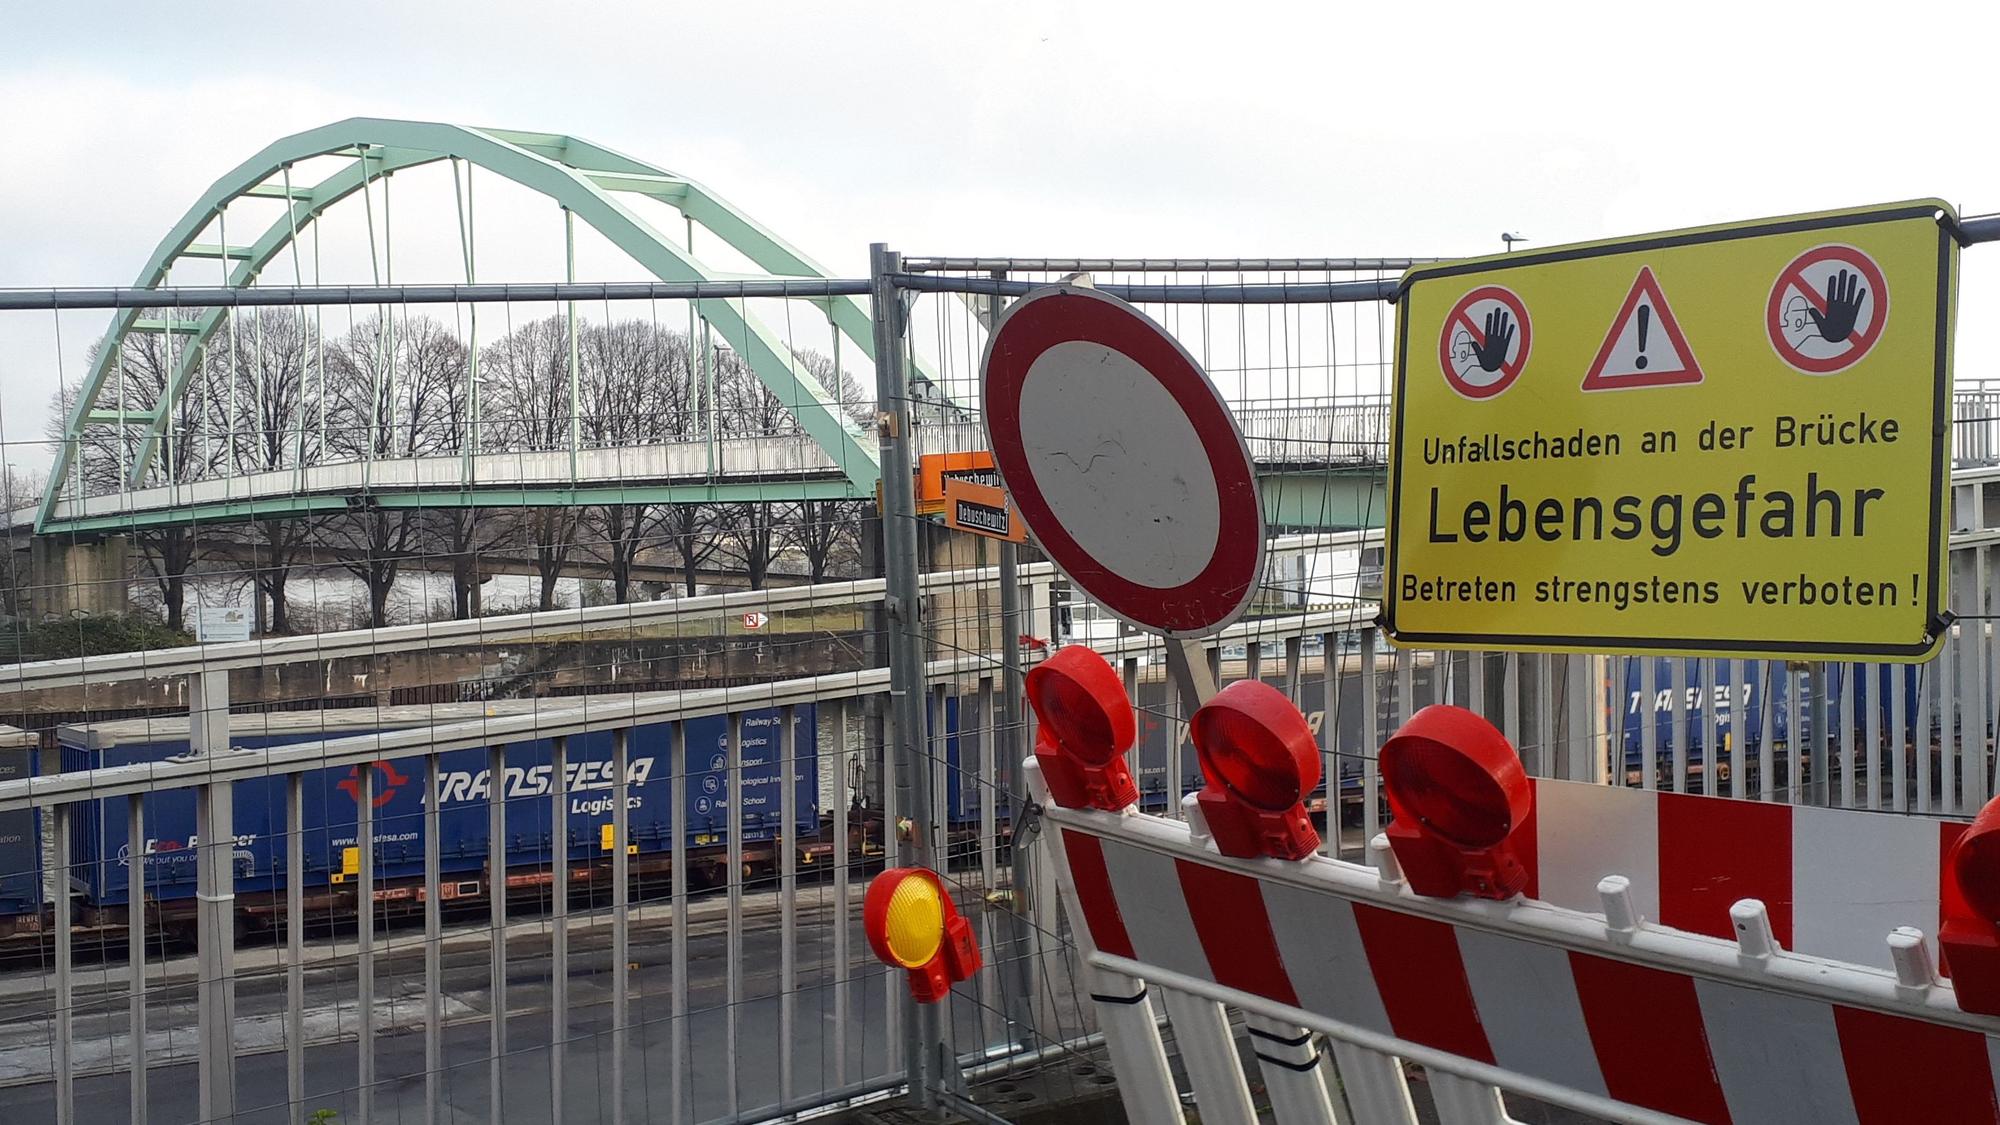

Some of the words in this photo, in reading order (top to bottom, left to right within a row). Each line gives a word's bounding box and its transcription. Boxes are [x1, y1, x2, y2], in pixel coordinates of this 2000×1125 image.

[1423, 428, 1620, 465] Unfallschaden
[1640, 430, 1676, 454] an
[1698, 420, 1754, 451] der
[1775, 412, 1899, 448] Brücke
[1428, 472, 1886, 557] Lebensgefahr
[1402, 574, 1516, 603] Betreten
[1534, 575, 1719, 611] strengstens
[740, 738, 768, 748] ogistics
[571, 796, 642, 816] Logiscs
